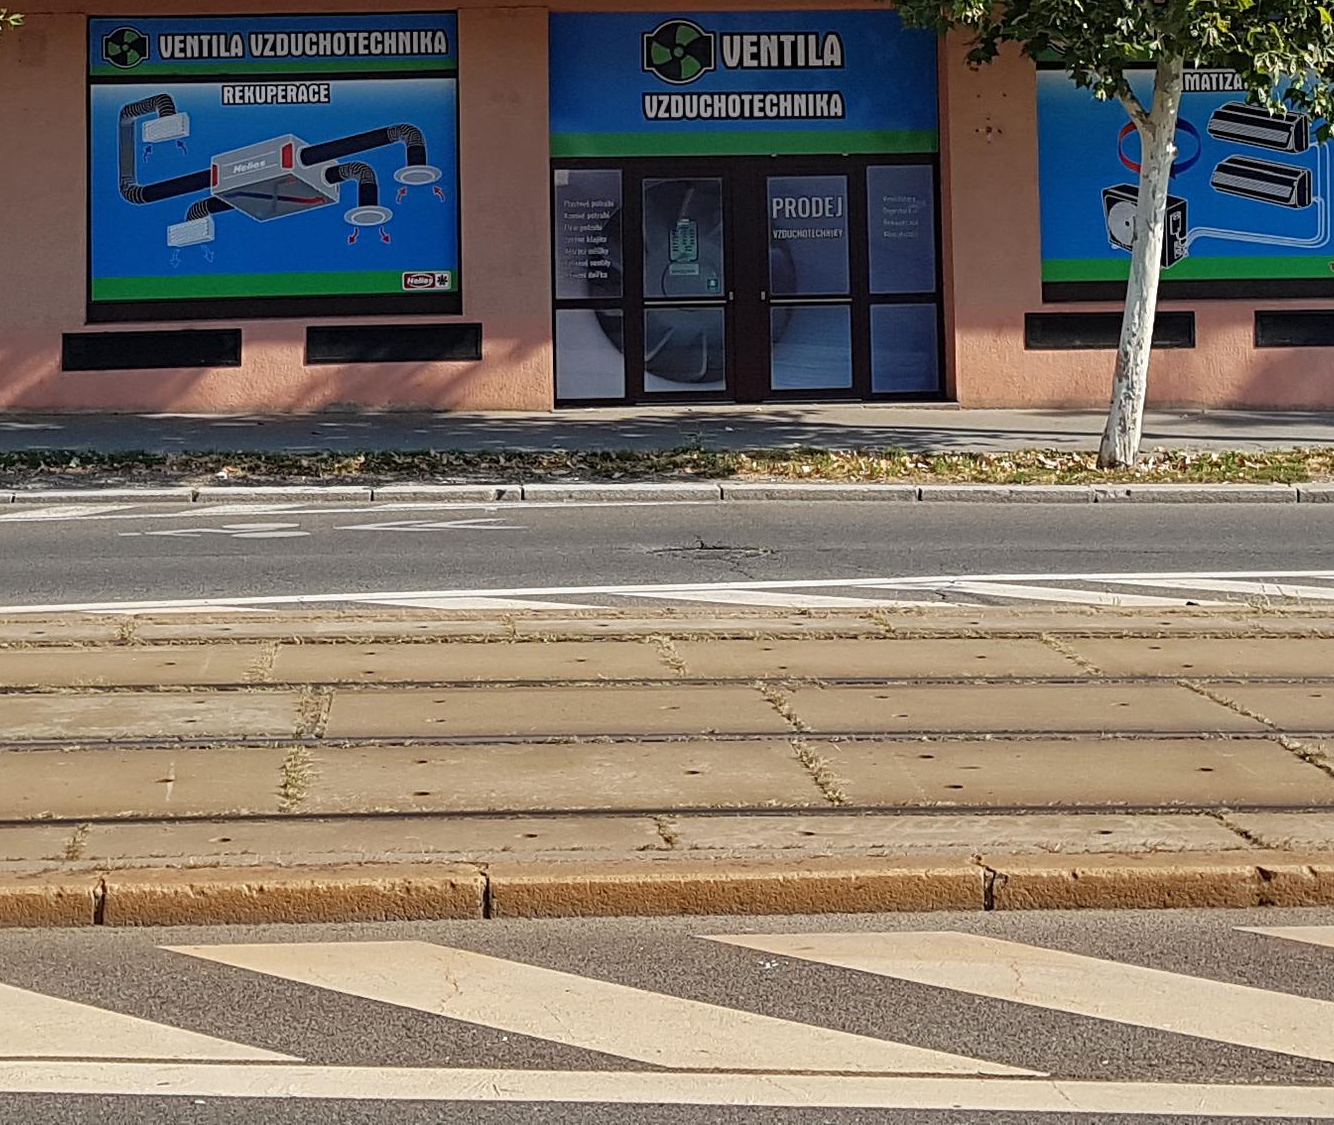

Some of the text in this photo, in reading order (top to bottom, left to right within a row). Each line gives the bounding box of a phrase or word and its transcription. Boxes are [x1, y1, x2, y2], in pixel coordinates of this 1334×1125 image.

[159, 30, 448, 58] VENTILA VZDUCHOTECHNIKA
[722, 33, 843, 68] VENTILA
[1184, 73, 1246, 91] MATIZA
[222, 84, 330, 105] REKUPERACE
[644, 93, 844, 119] VZDUCHOTECHNIKA
[771, 196, 844, 219] PRODEJ
